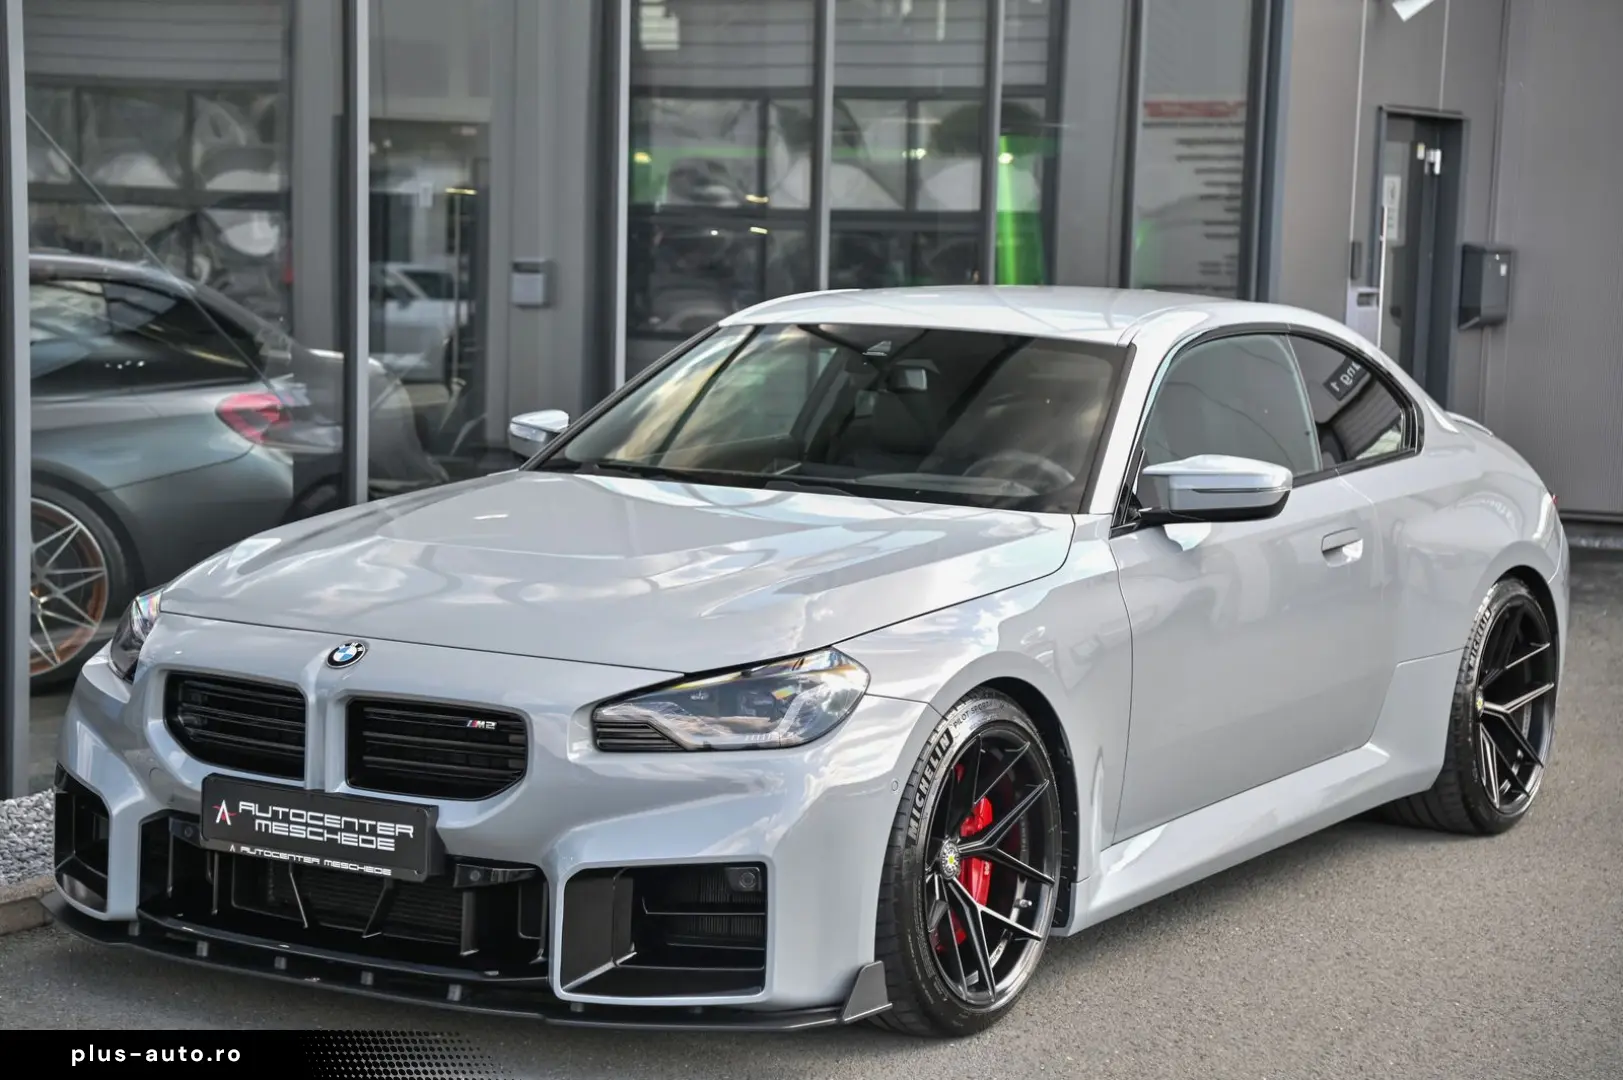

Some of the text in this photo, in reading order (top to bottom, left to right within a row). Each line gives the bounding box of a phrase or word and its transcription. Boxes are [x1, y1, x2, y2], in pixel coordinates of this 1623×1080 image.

[907, 734, 952, 842] MICHELIN
[239, 801, 414, 838] AUTOCENTER
[255, 819, 396, 851] MESCHEDE
[240, 846, 392, 876] AUTOCENTER MESCHEDE
